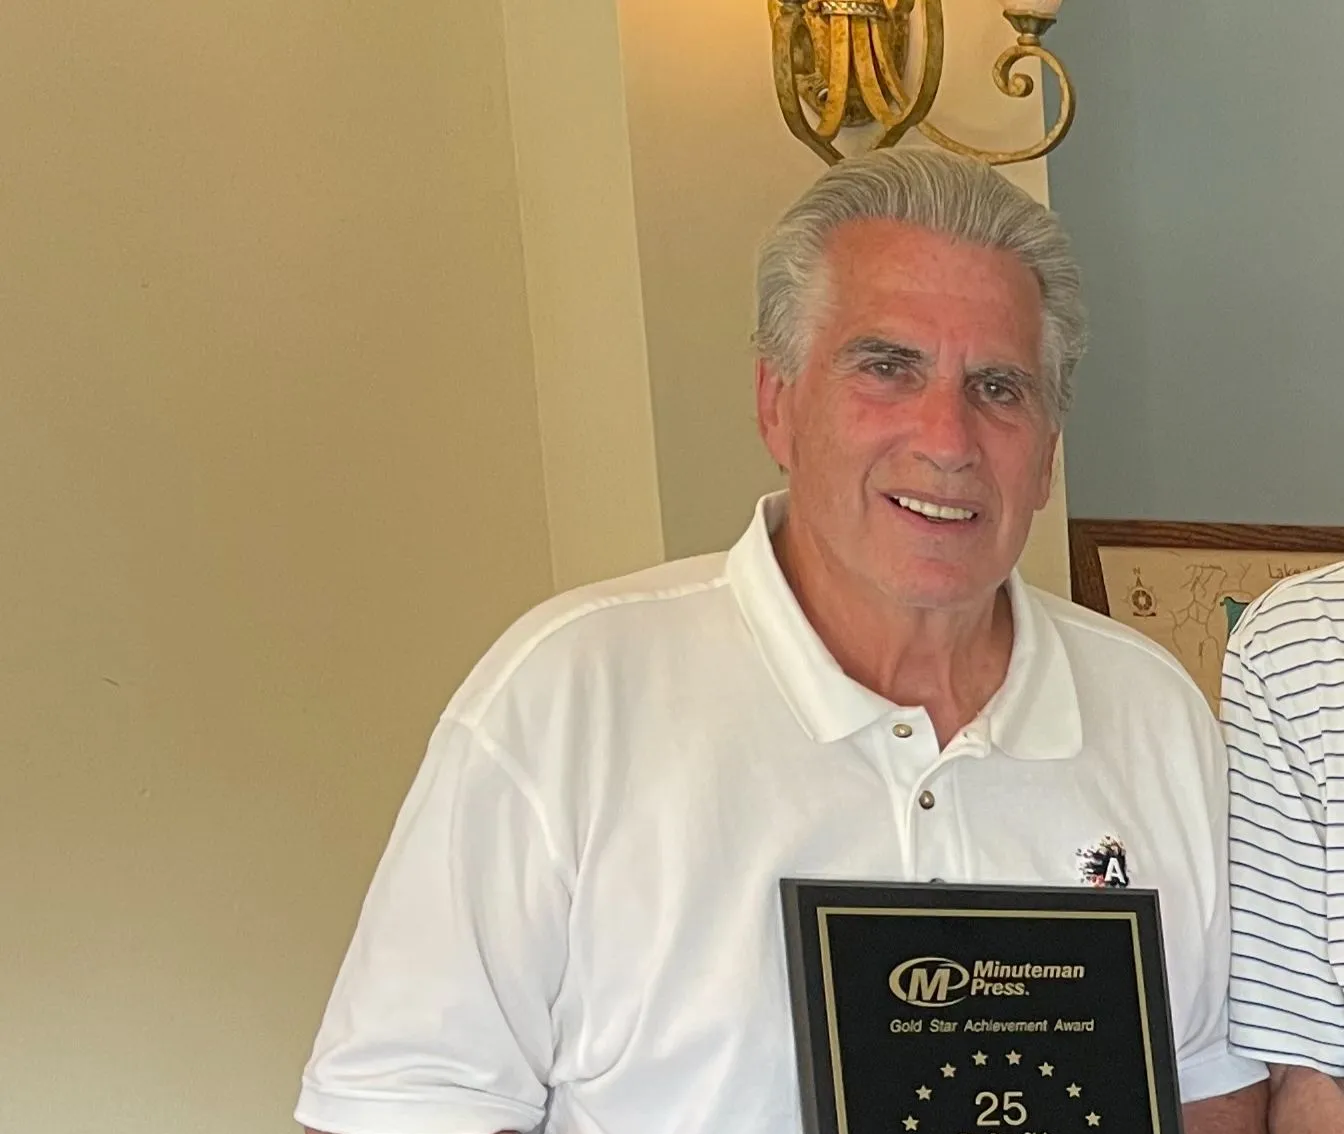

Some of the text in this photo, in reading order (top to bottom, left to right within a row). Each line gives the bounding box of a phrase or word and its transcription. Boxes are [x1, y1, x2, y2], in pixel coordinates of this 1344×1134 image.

[973, 961, 1084, 979] Minuteman
[890, 1019, 1094, 1032] Gold Star Achievement Award
[975, 1091, 1027, 1126] 25
